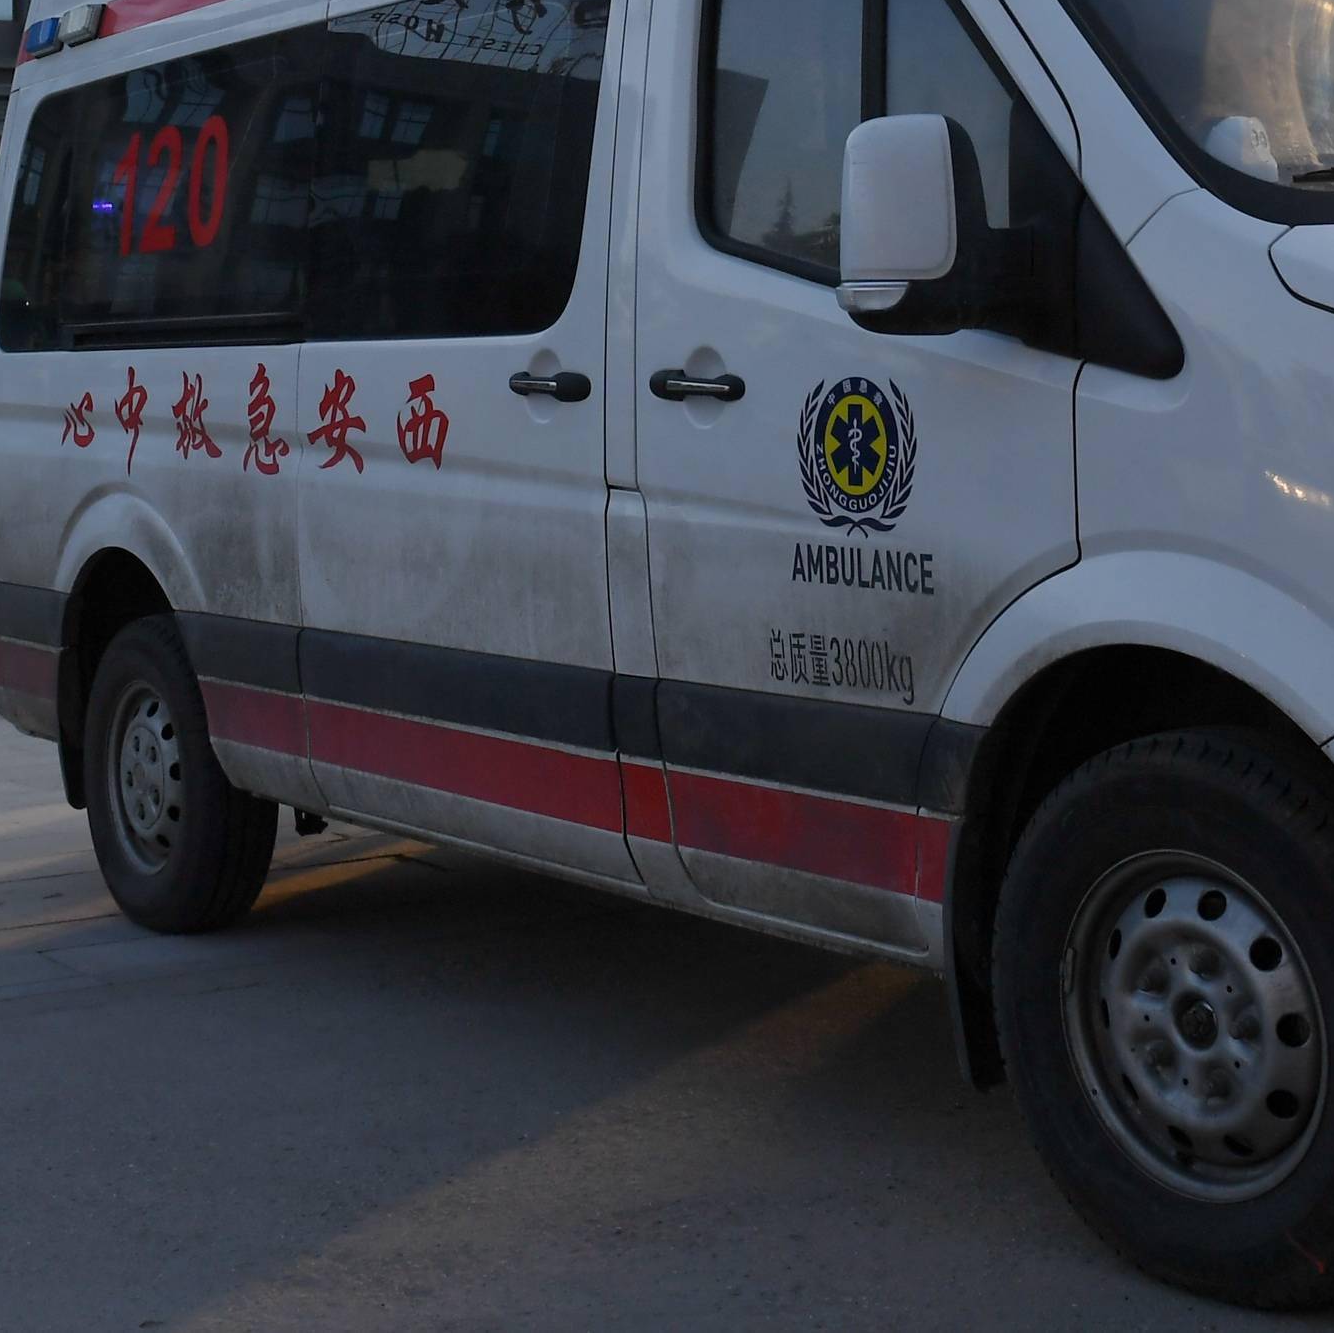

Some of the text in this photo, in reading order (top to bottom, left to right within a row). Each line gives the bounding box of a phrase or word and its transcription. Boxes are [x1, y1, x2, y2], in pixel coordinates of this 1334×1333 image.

[113, 114, 229, 257] 120
[792, 542, 934, 595] AMBULANCE
[770, 628, 915, 705] 总质量3800kg
